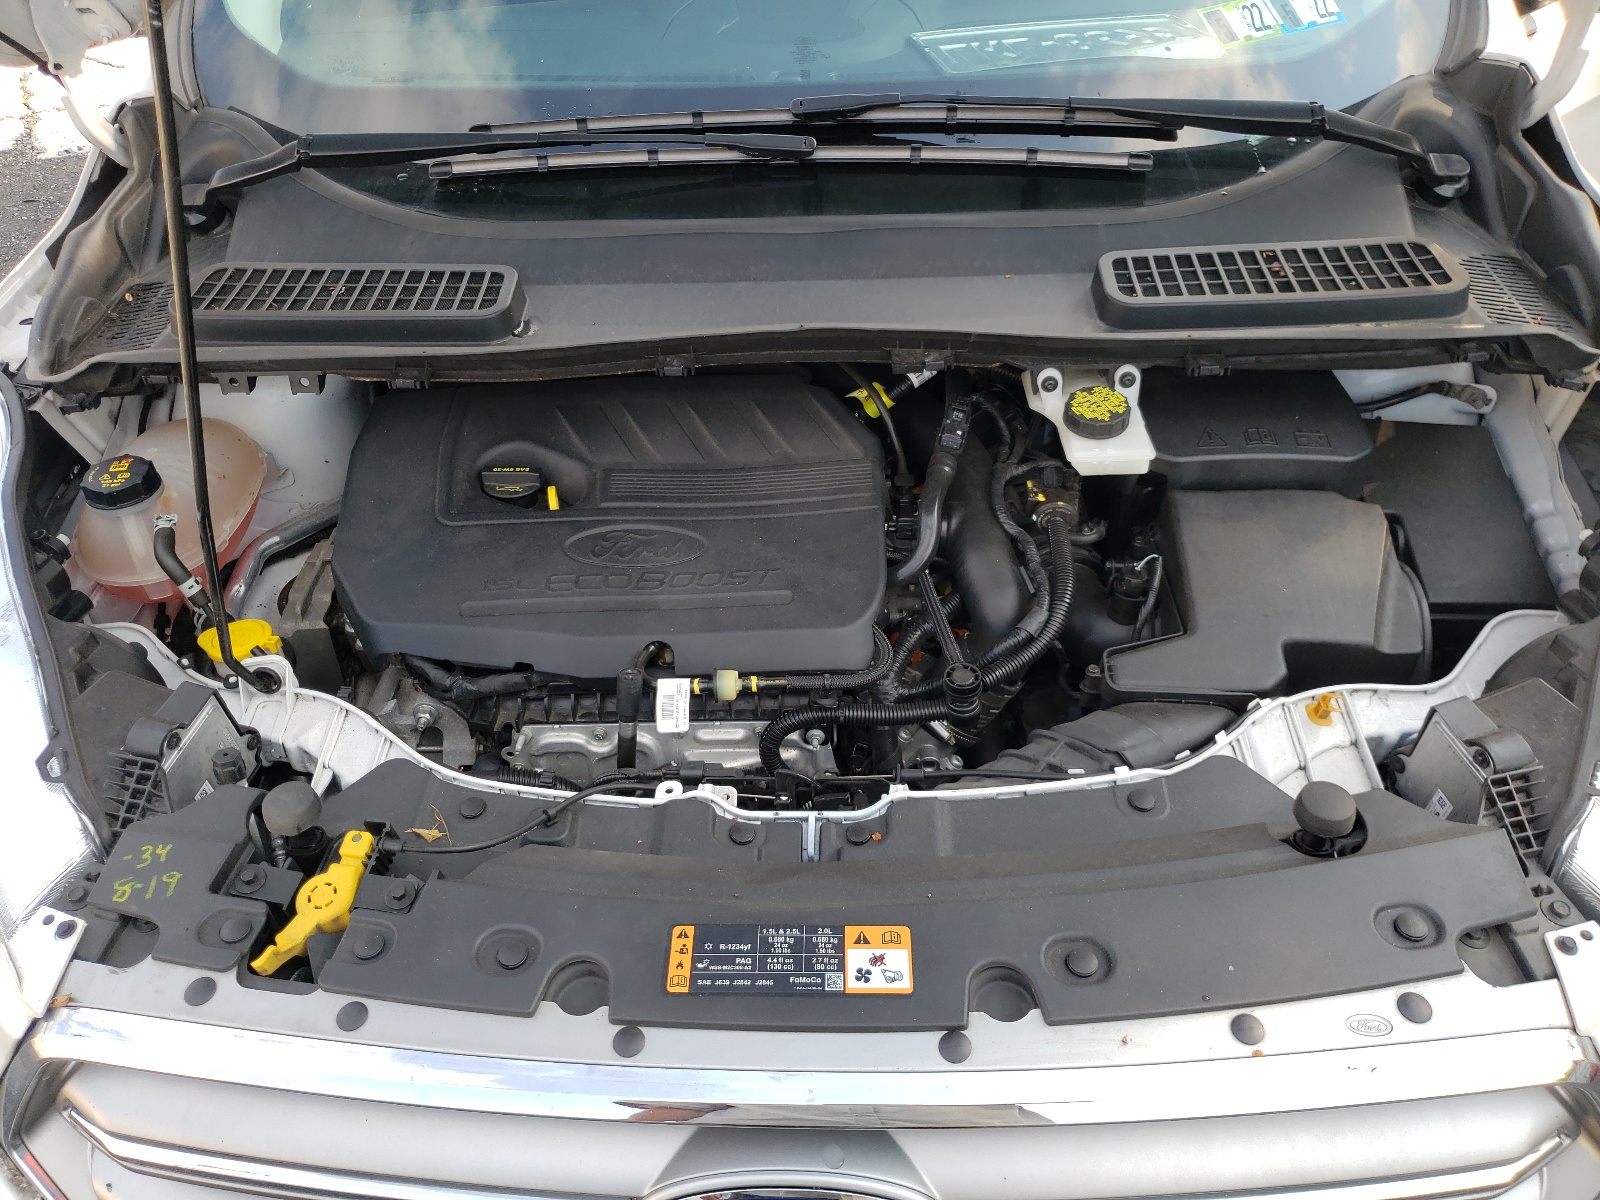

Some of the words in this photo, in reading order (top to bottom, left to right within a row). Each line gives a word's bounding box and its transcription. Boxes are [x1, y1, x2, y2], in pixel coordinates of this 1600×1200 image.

[1241, 3, 1273, 32] 22
[588, 529, 684, 560] Ford
[111, 871, 183, 903] 8-19
[719, 943, 751, 951] R-1234yf
